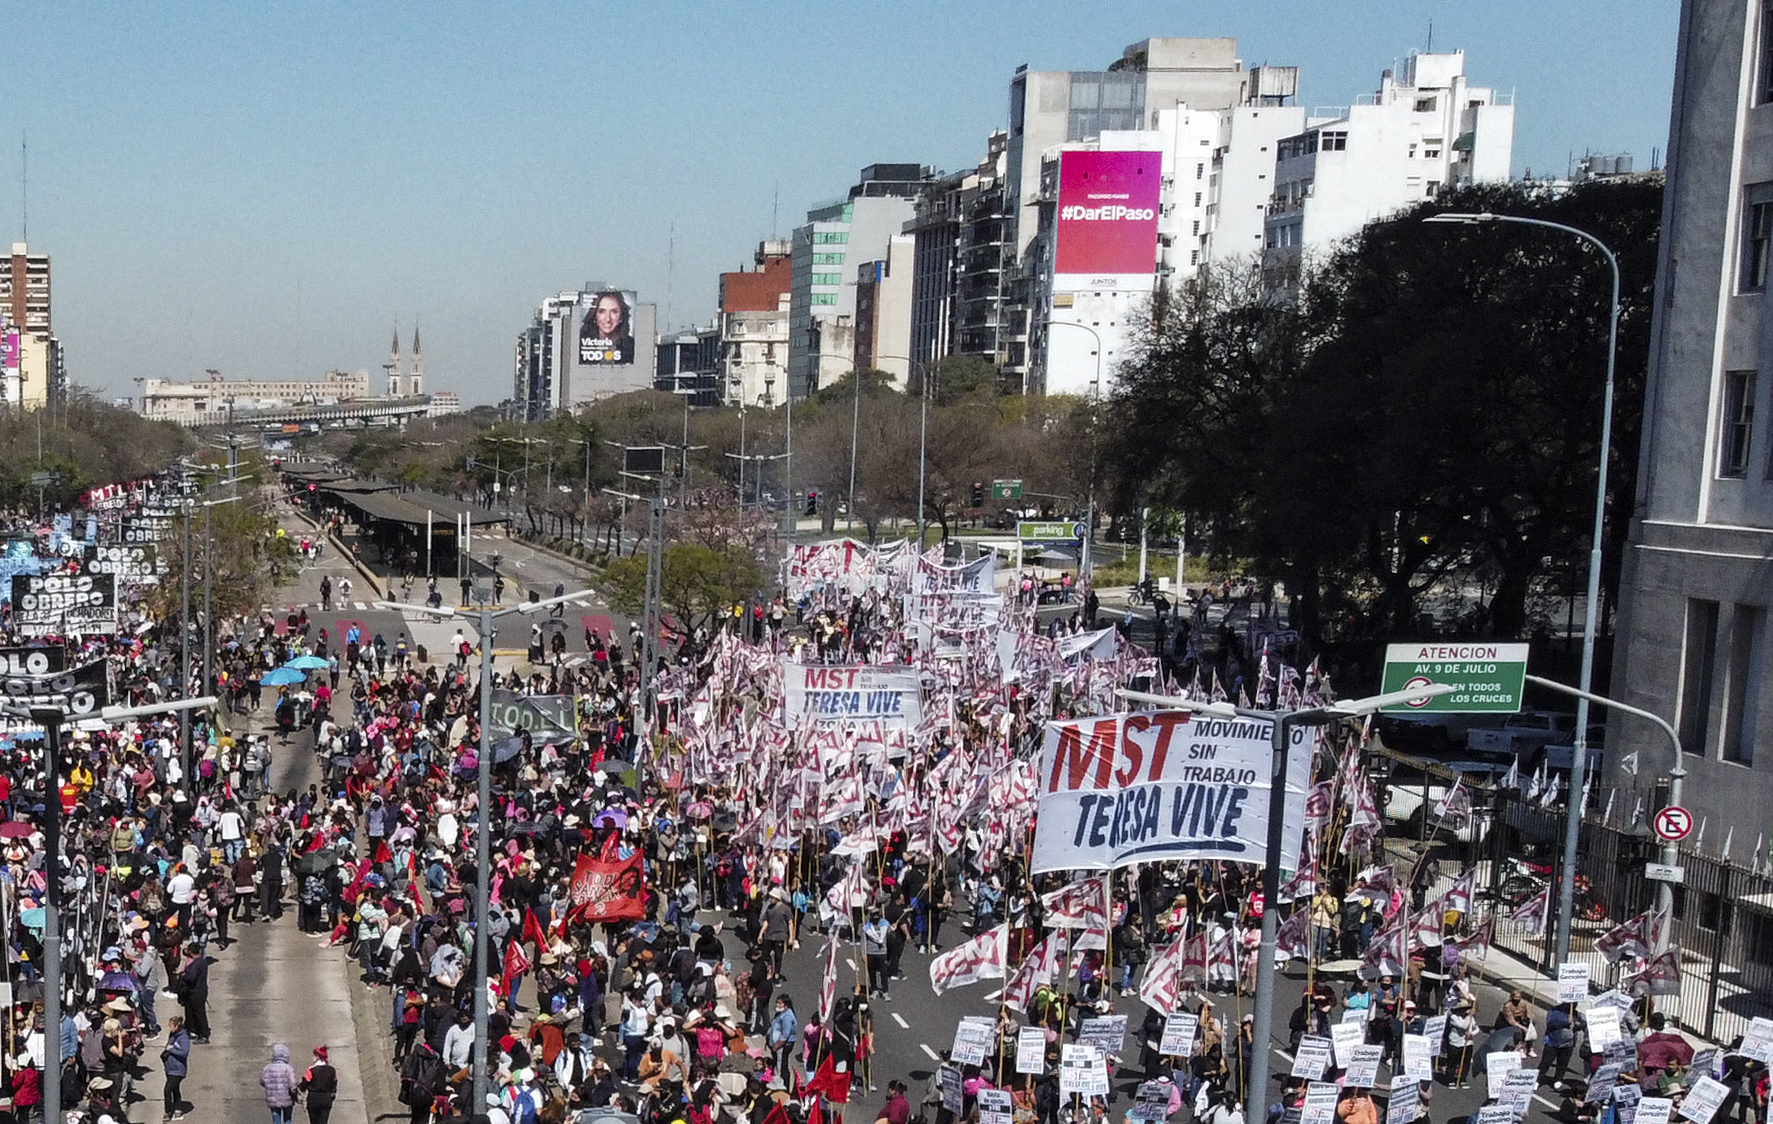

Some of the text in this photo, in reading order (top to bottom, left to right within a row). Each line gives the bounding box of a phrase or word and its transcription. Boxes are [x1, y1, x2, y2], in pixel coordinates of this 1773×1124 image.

[1062, 205, 1154, 221] #DarElPaso
[581, 338, 612, 346] Victoria
[1033, 526, 1064, 537] parking
[30, 576, 93, 593] POLO
[21, 591, 104, 611] OBRERO
[1418, 647, 1497, 660] ATENCION
[1415, 664, 1497, 674] AV. 9 DE JULIO
[804, 668, 859, 690] MST
[1469, 683, 1501, 691] TODOS
[803, 691, 860, 714] TERESA
[866, 691, 903, 713] VIVE
[1450, 694, 1512, 703] LOS CRUCES
[1194, 720, 1305, 745] MOVIMIEO
[1049, 710, 1192, 792] MST
[1188, 744, 1217, 760] SIN
[1183, 767, 1256, 785] TRABAJO
[1074, 783, 1249, 847] TERESA VIVE
[1480, 1110, 1511, 1119] Trabajo
[1638, 1110, 1669, 1118] Genuino
[1640, 1103, 1668, 1112] Trabajo
